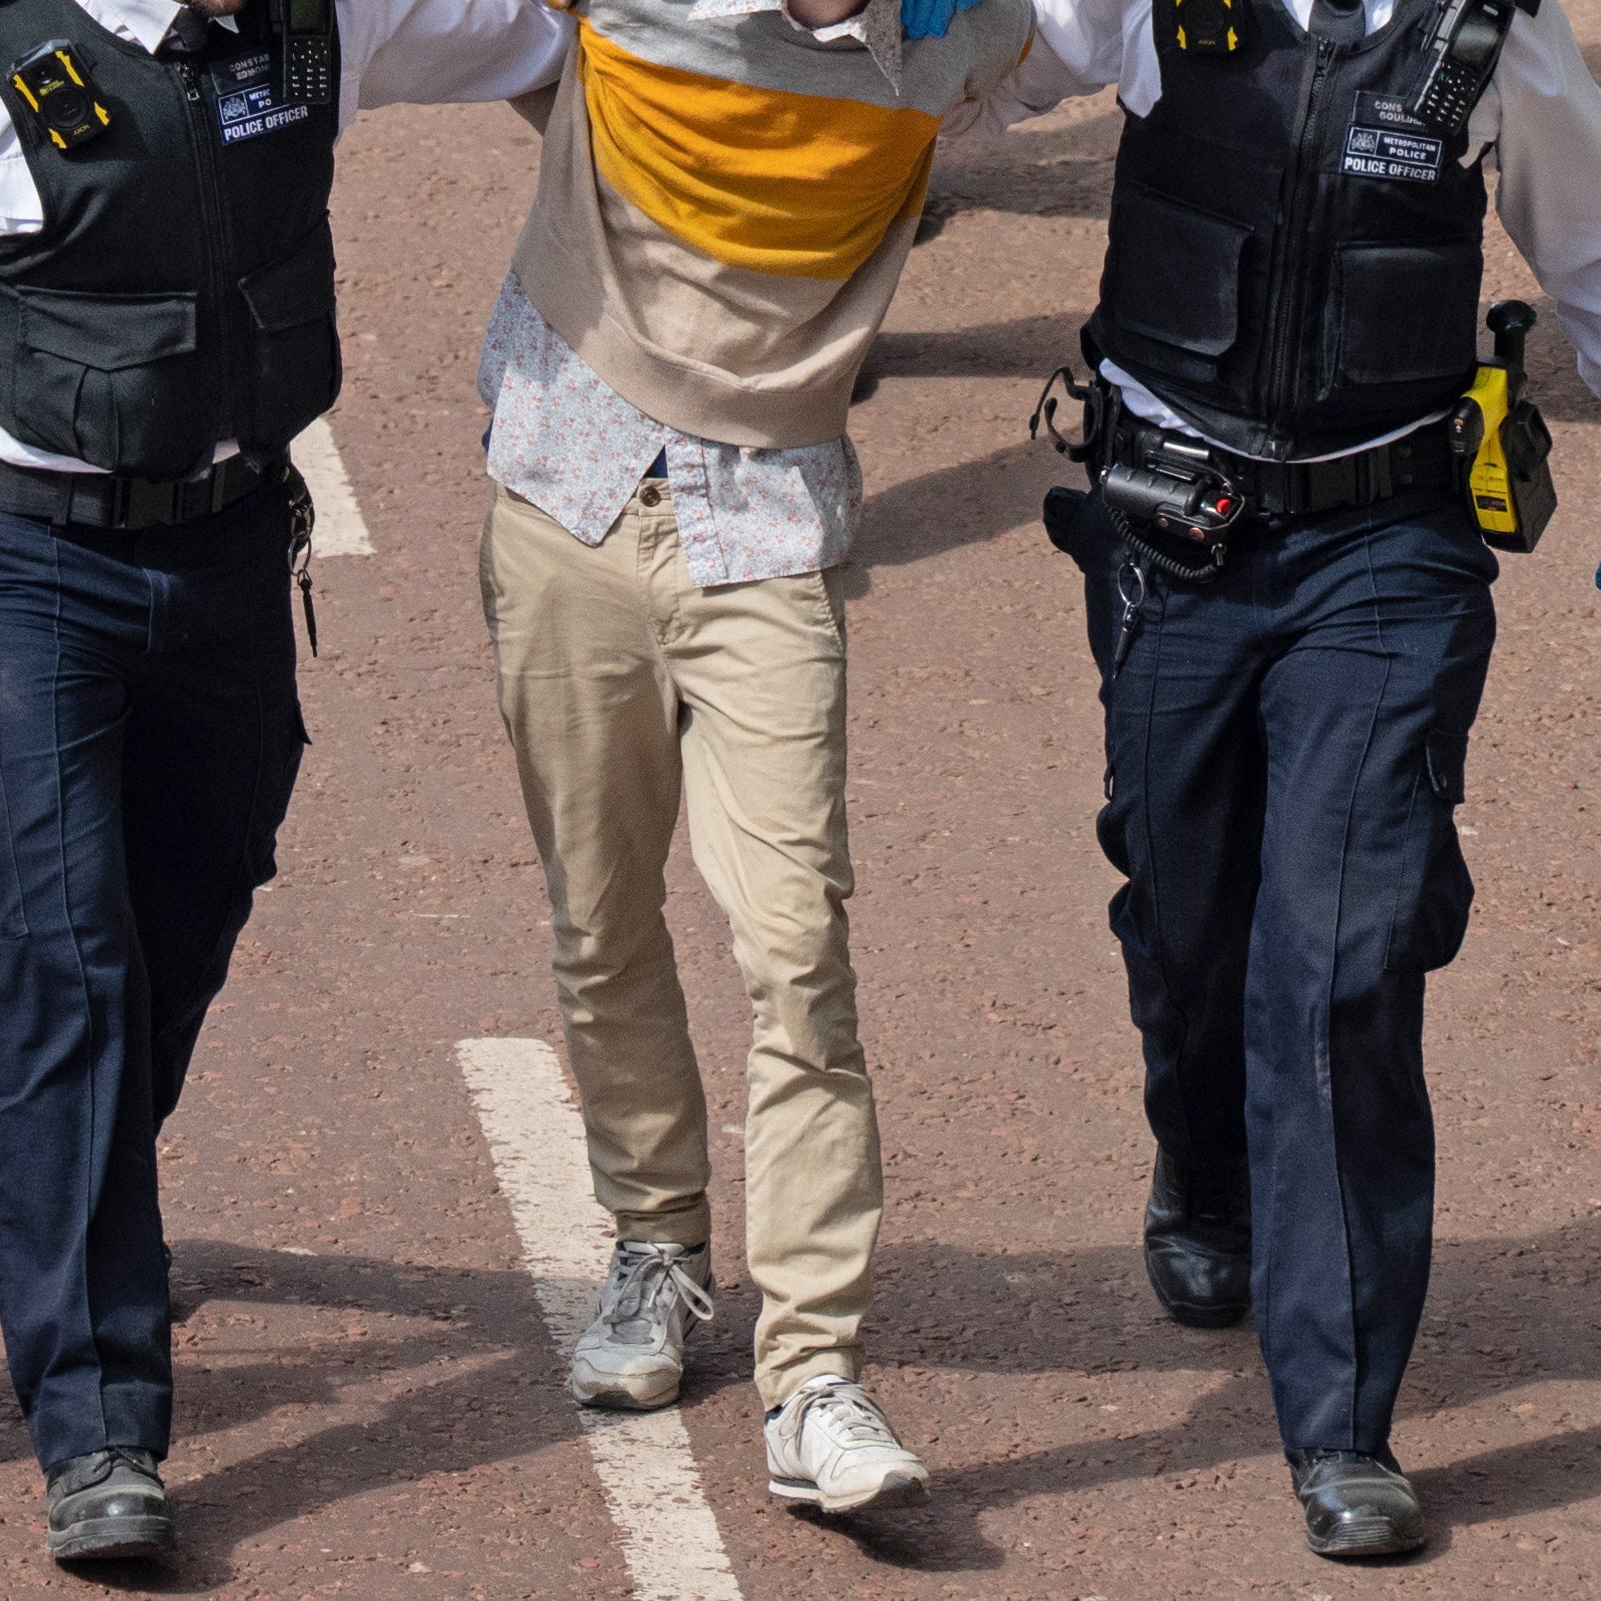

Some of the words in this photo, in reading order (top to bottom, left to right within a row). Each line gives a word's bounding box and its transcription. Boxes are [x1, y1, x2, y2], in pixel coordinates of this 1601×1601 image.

[224, 119, 264, 141] POLICE
[265, 105, 308, 129] OFFICER
[1383, 136, 1436, 151] METROPOLITAN
[1389, 147, 1427, 160] POLICE
[1344, 156, 1386, 174] POLICE
[1389, 163, 1436, 181] OFFICER
